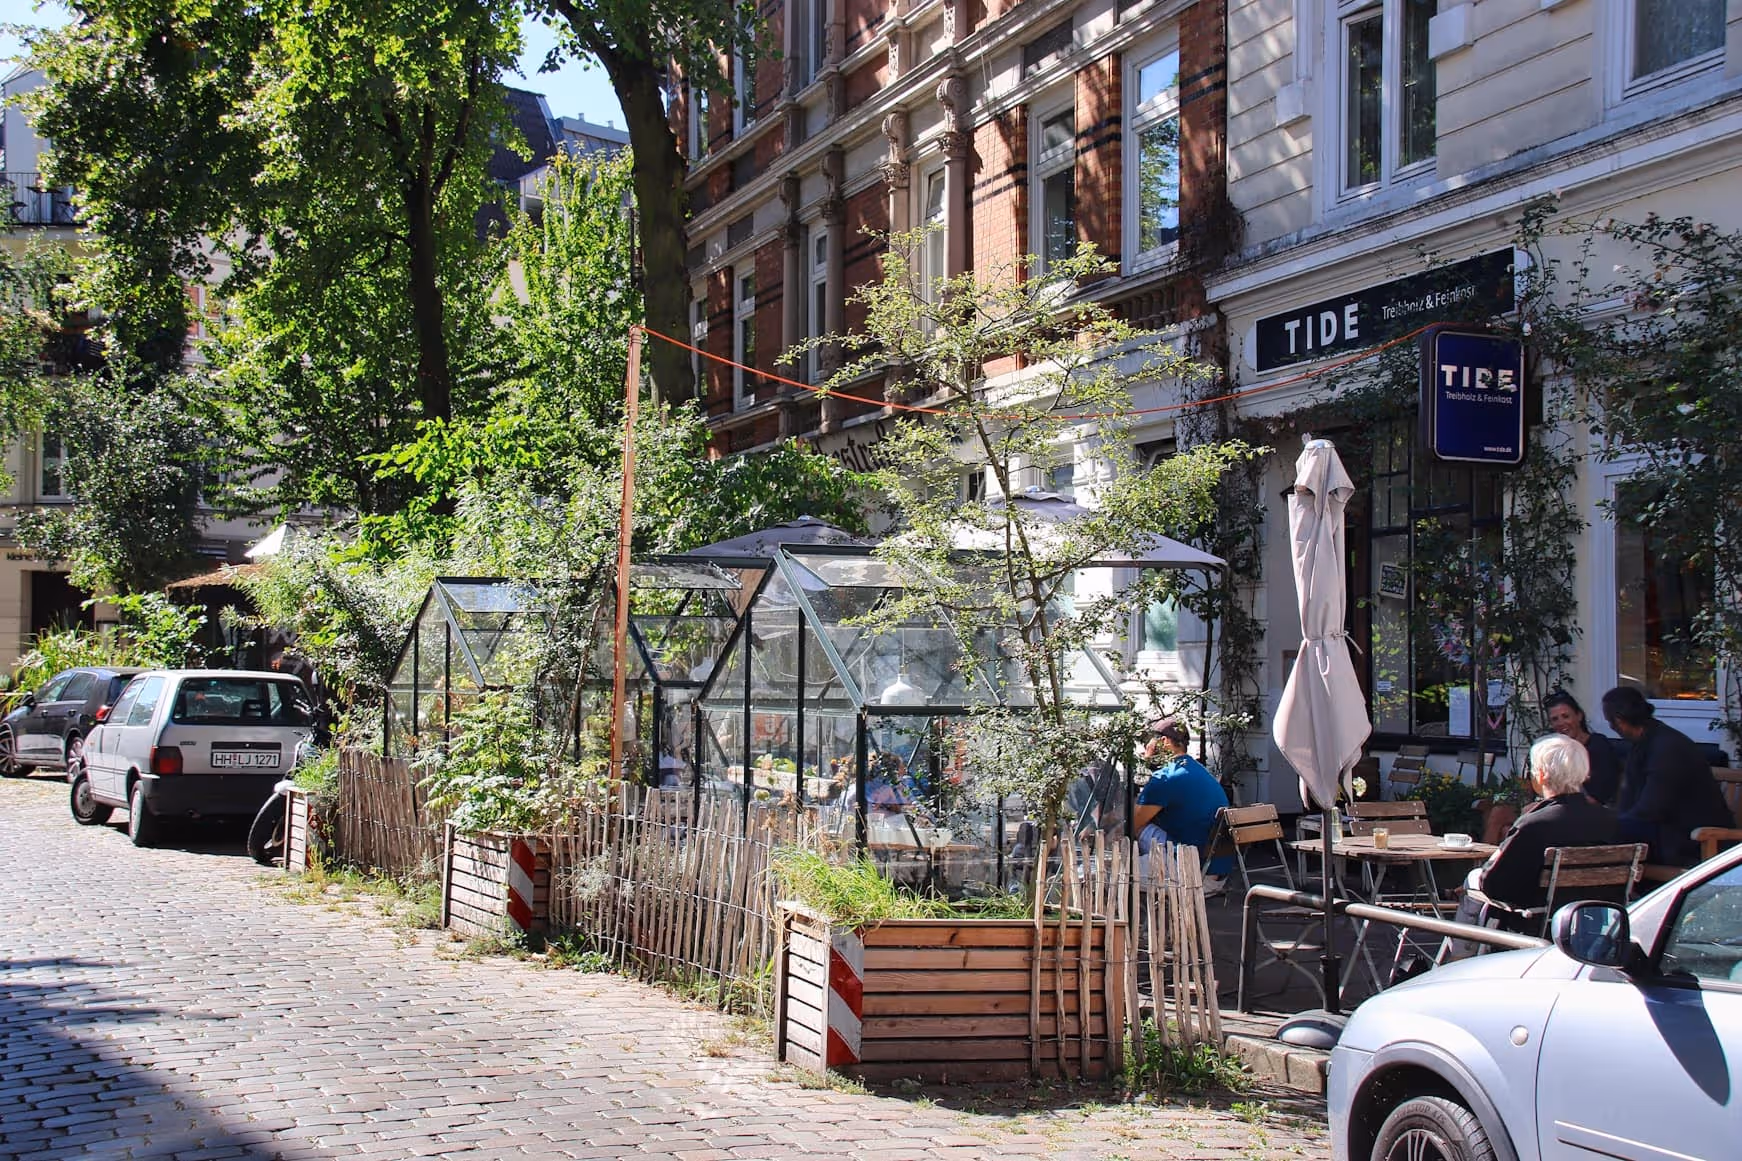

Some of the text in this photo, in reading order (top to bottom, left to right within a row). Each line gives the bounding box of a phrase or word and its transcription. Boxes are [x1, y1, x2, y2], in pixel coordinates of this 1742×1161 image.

[1425, 294, 1435, 309] &
[1284, 302, 1359, 354] TIDE
[1440, 364, 1514, 390] TIDE
[1446, 391, 1513, 404] Treibholz & Feinkost
[255, 754, 278, 765] 1271
